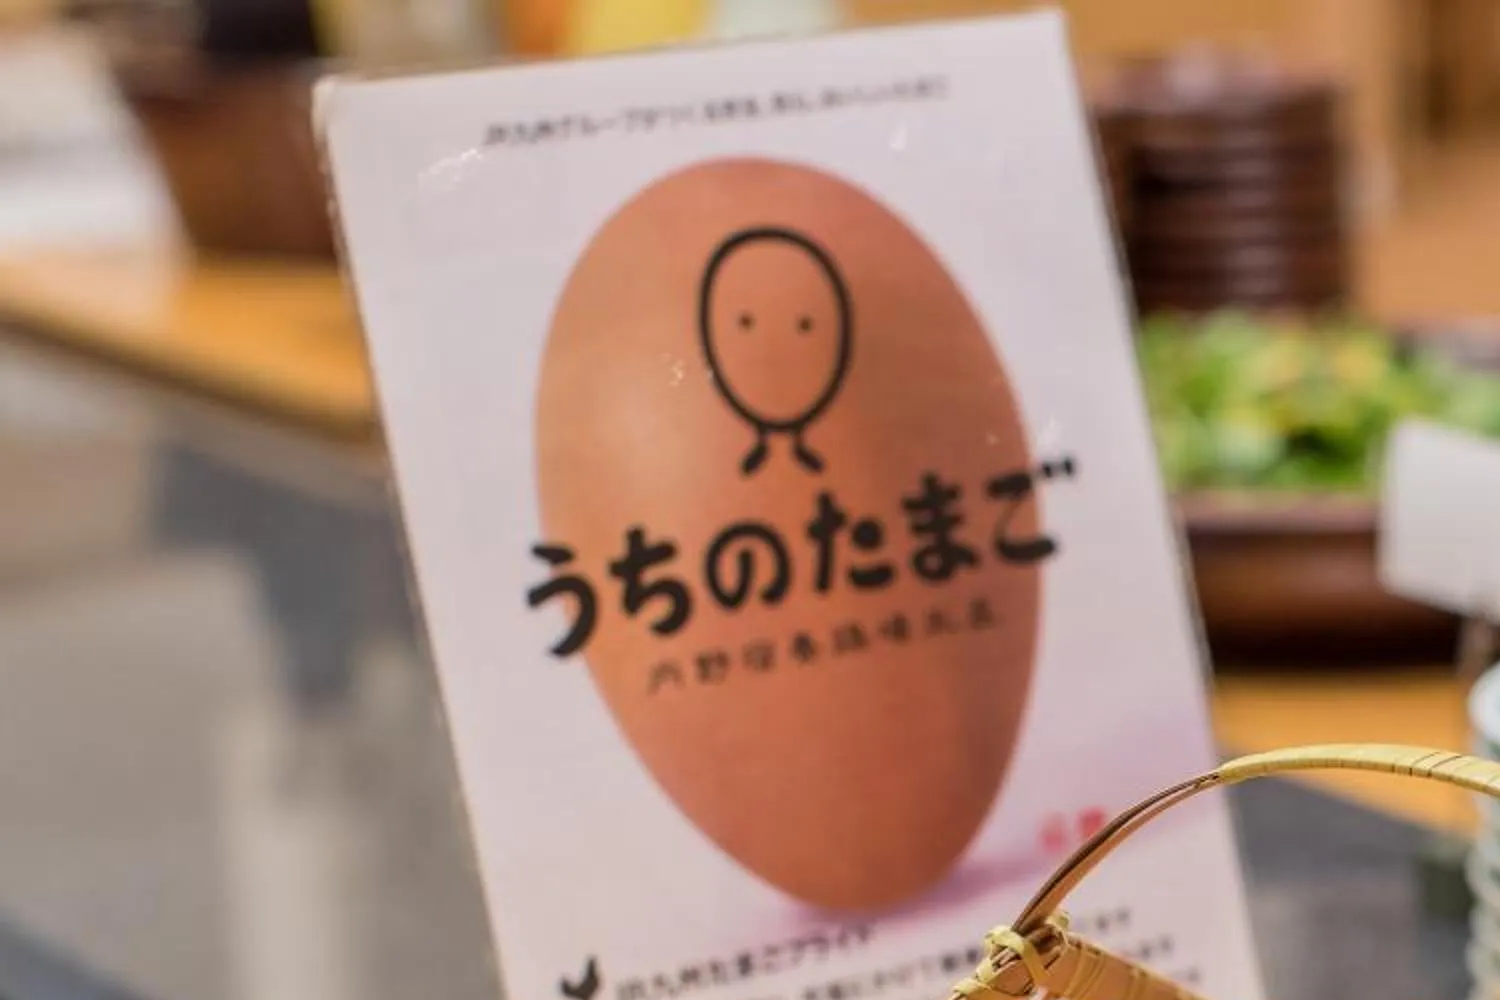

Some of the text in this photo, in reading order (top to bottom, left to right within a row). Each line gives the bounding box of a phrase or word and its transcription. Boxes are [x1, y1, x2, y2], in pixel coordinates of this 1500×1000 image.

[525, 456, 1078, 661] うちのたまご
